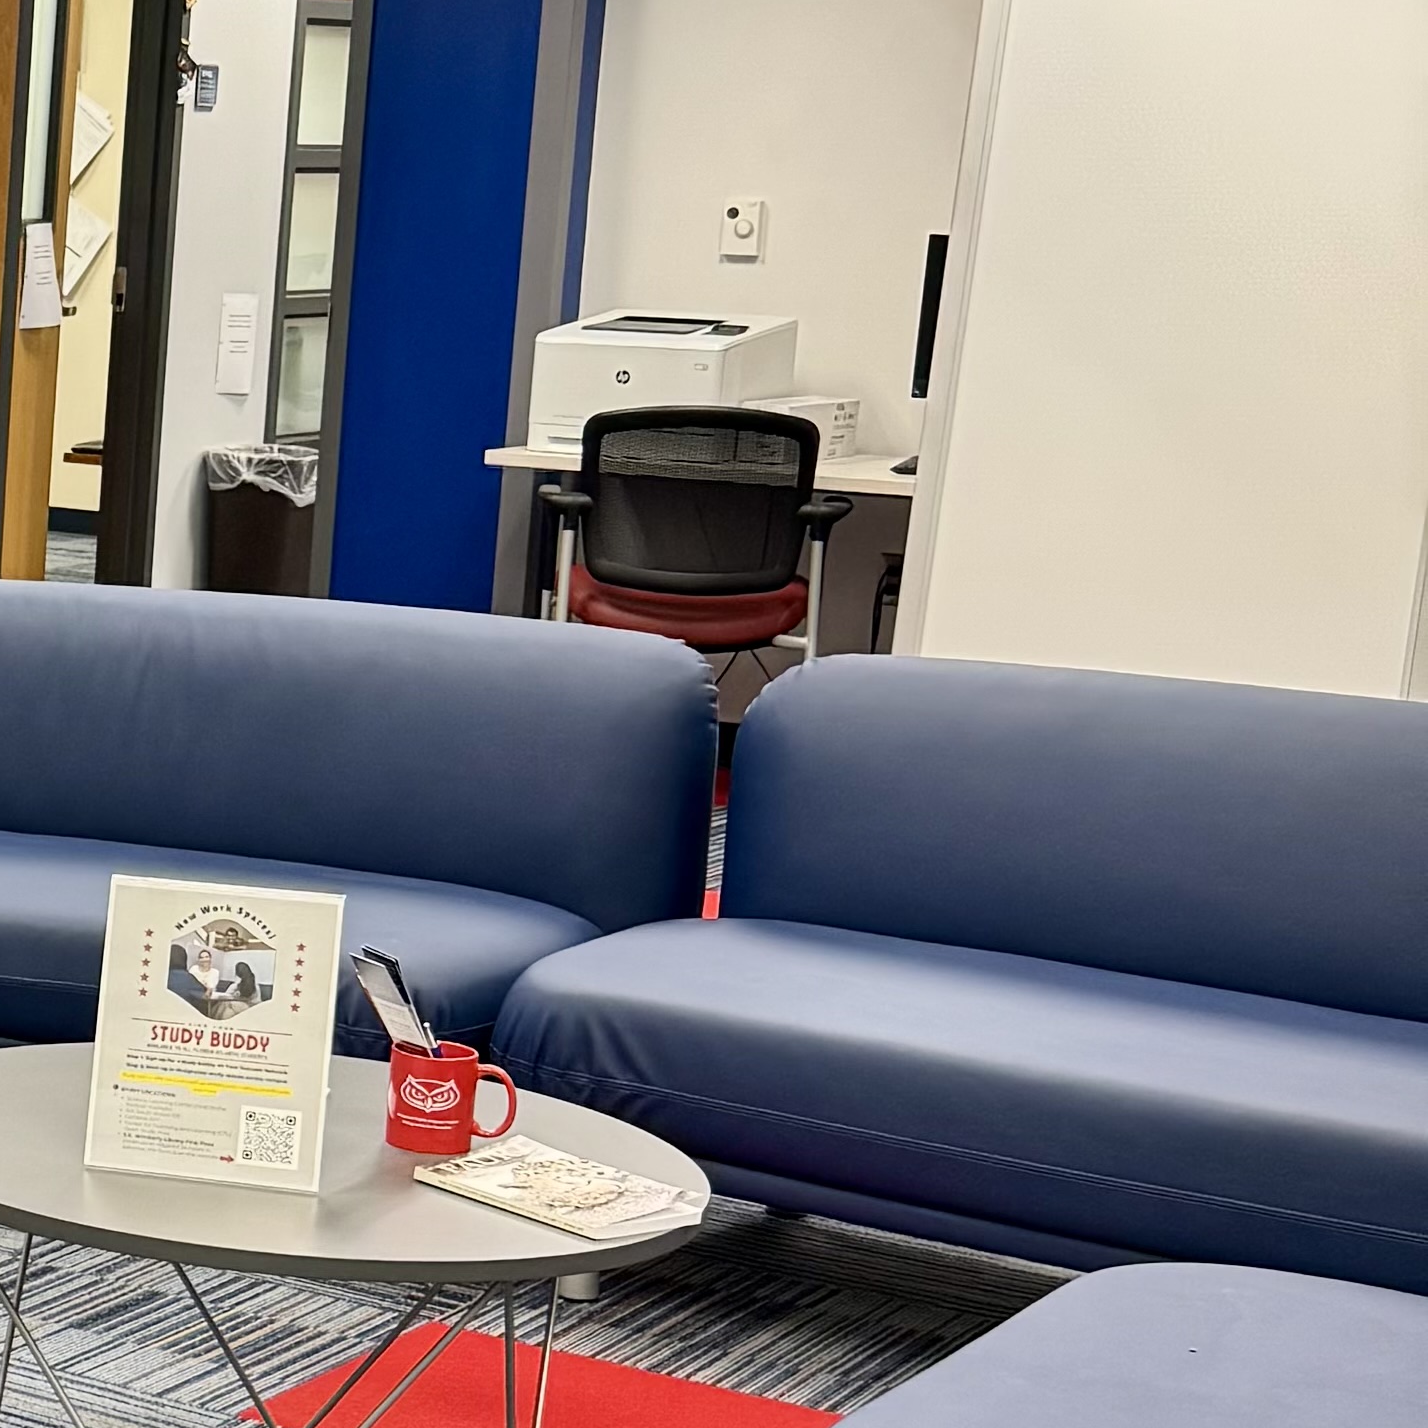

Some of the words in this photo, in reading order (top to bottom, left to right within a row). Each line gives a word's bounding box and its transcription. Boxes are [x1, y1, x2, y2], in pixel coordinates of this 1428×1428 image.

[175, 913, 197, 931] New
[200, 904, 232, 915] Work
[151, 1024, 204, 1046] STUDY
[210, 1031, 270, 1053] BUDDY
